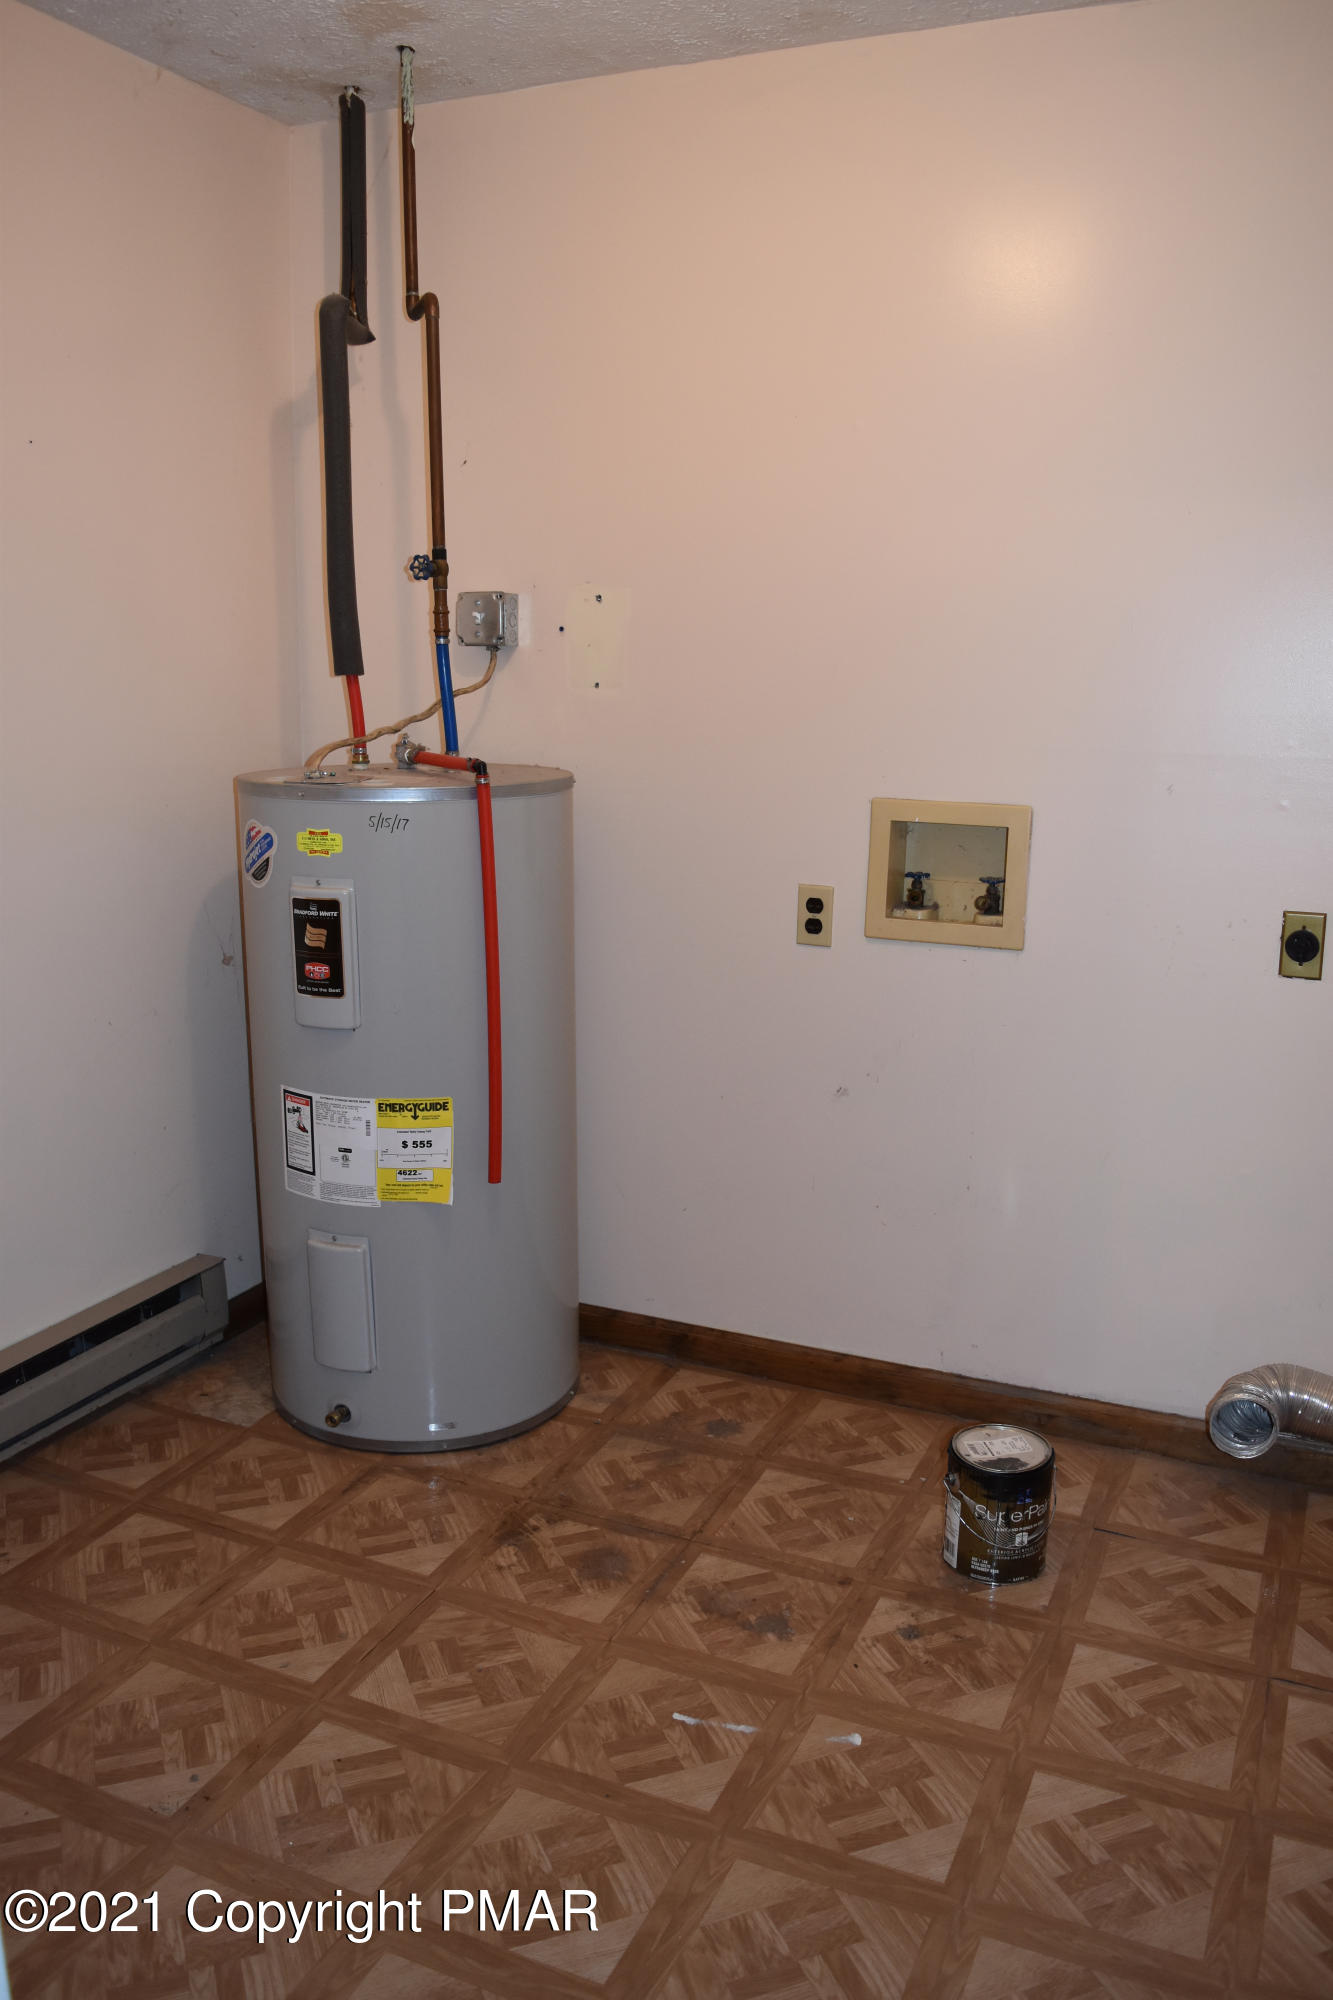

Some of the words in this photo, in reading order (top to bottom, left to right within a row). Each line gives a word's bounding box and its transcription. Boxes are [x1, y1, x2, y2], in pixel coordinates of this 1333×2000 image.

[368, 812, 410, 834] 5/15/17
[377, 1101, 450, 1114] ENERGYGUIDE
[401, 1140, 409, 1149] $
[412, 1139, 433, 1149] 555
